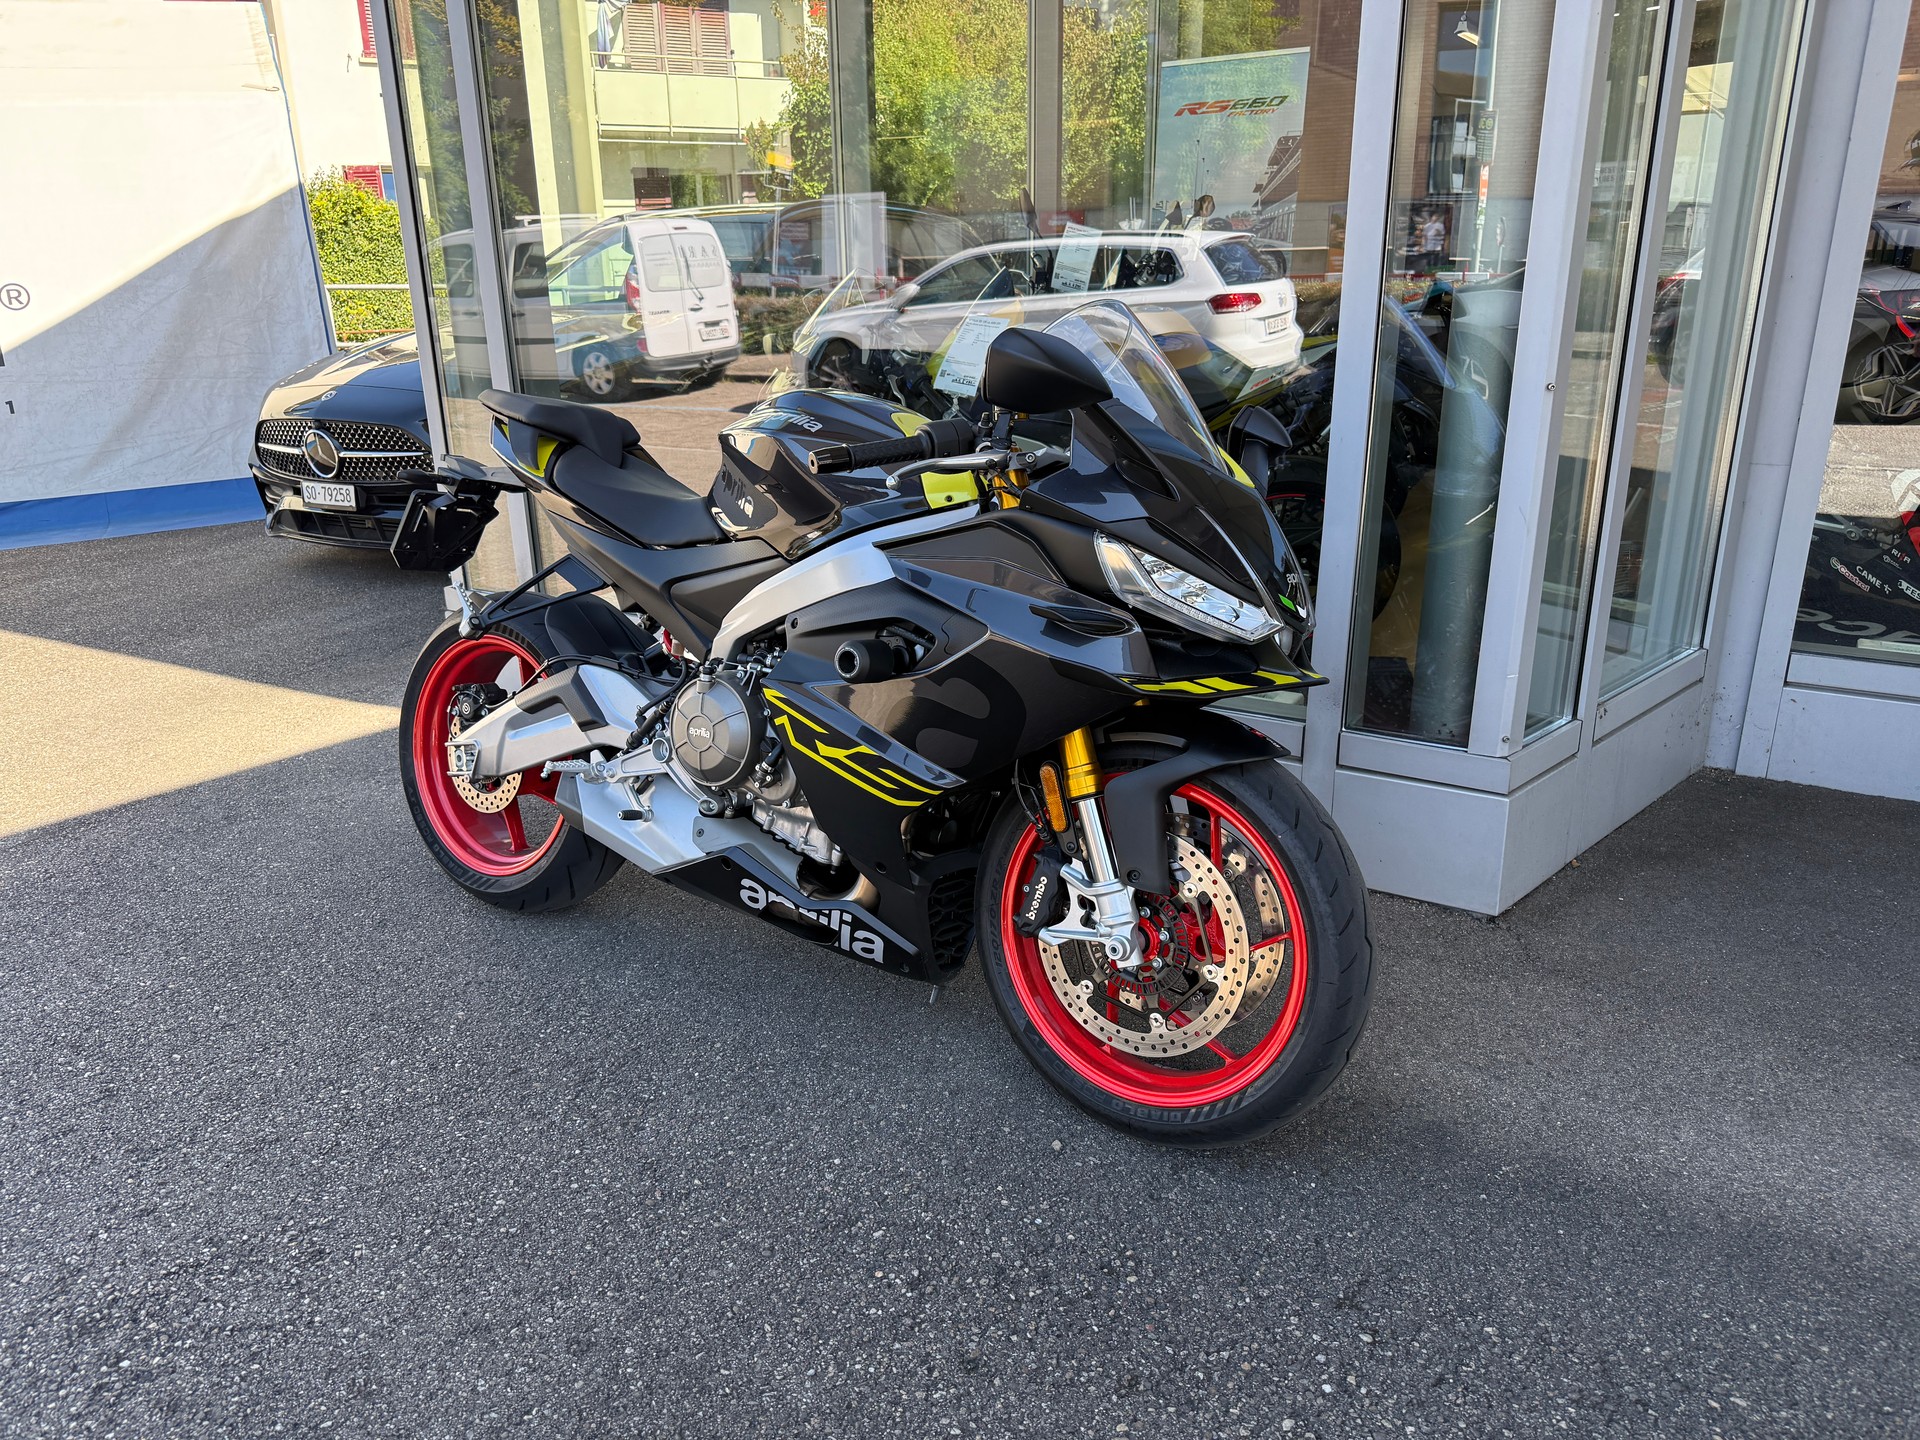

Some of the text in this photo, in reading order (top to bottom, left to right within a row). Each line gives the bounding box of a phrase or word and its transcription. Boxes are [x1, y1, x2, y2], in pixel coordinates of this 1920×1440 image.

[1227, 107, 1279, 117] FACTORY
[1838, 564, 1871, 593] Castrol
[1856, 565, 1882, 589] CAME
[689, 727, 711, 739] aprilia
[1025, 876, 1048, 921] brembo
[1109, 1097, 1182, 1121] DIABLO
